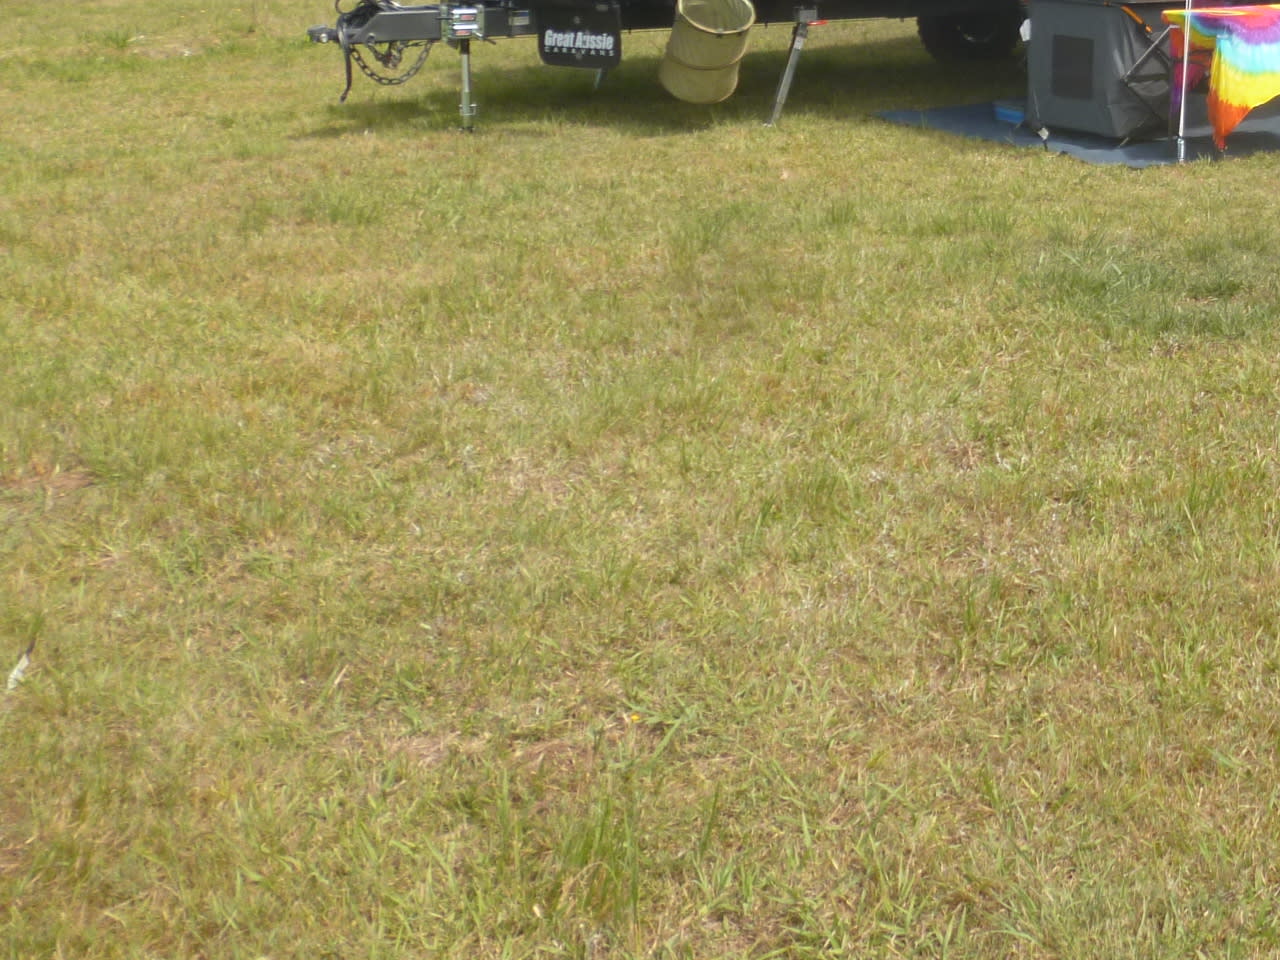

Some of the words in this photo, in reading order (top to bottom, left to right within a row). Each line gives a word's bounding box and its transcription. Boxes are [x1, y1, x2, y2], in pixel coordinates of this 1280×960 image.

[544, 29, 576, 47] Great
[575, 31, 615, 50] Aussie
[544, 46, 615, 56] CARAVANS
